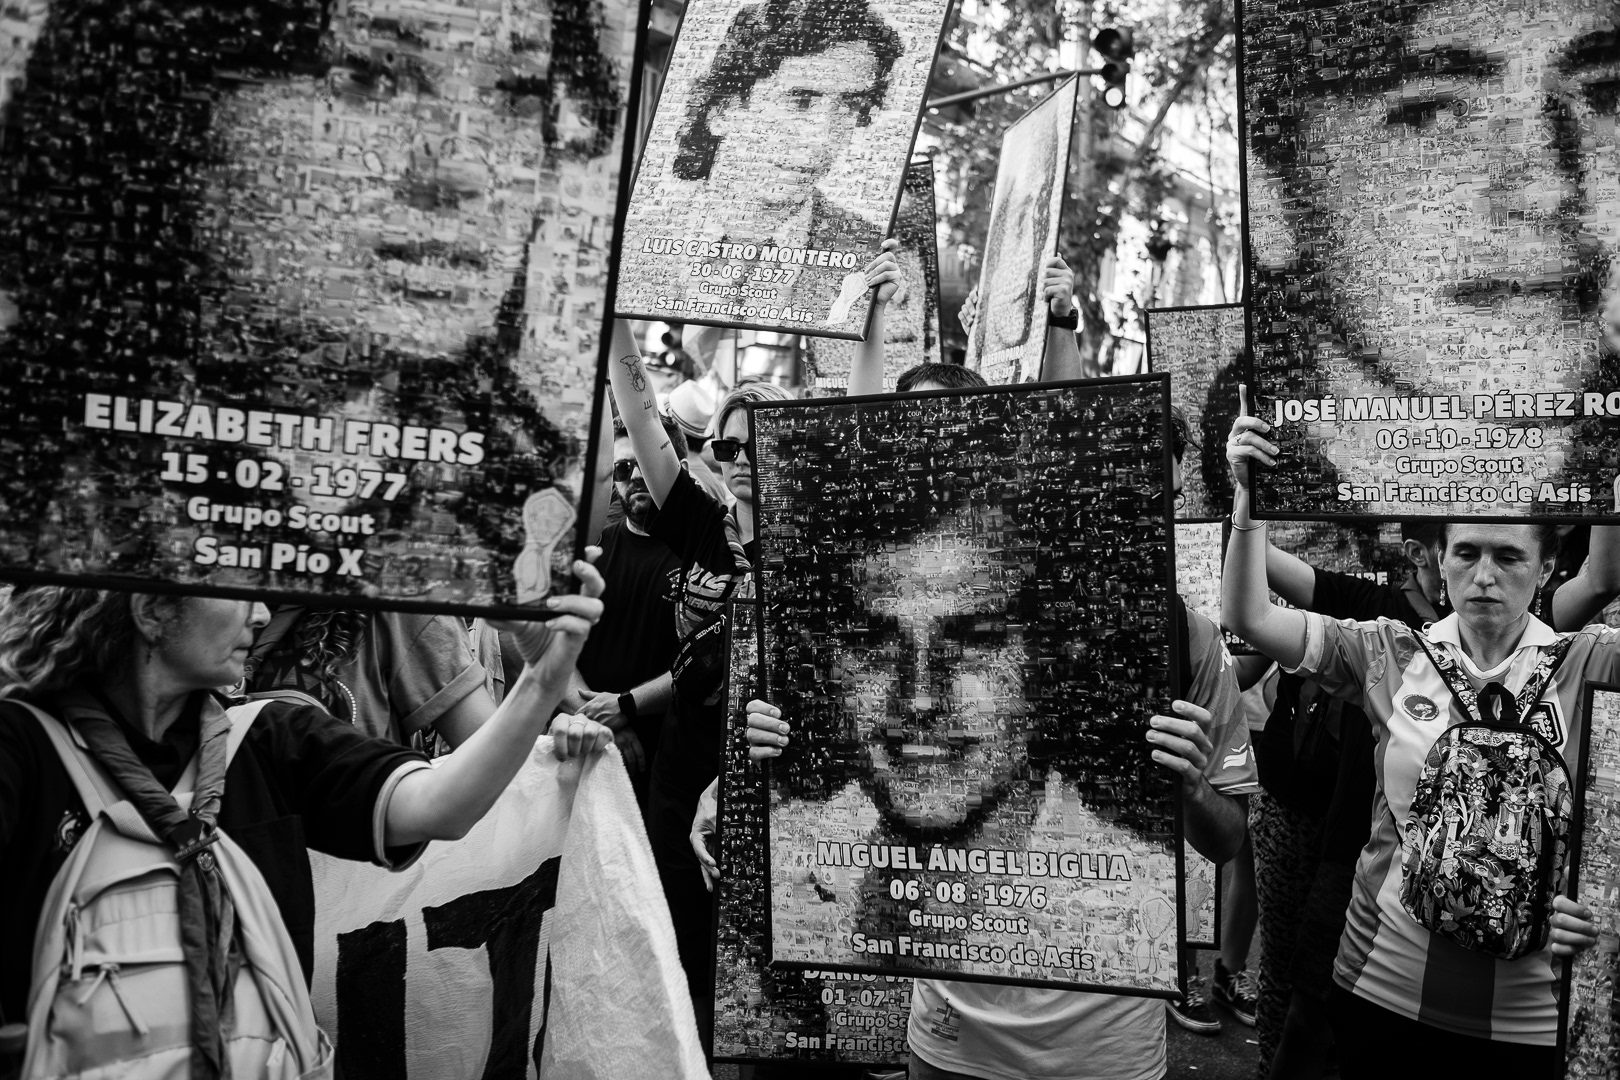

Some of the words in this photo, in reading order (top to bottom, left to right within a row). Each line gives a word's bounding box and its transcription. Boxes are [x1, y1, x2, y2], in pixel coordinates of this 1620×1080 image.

[642, 238, 684, 255] LUIS
[685, 240, 756, 261] CASTRO
[759, 246, 857, 269] MONTERO
[691, 262, 711, 277] 30
[721, 265, 743, 280] 06
[752, 267, 795, 285] 1977
[699, 281, 738, 298] Grupo
[739, 284, 778, 300] Scout
[655, 296, 684, 312] San
[686, 298, 756, 318] Francisco
[759, 305, 778, 320] de
[780, 306, 814, 324] Asís
[1272, 394, 1337, 428] JOSÉ
[1342, 396, 1468, 422] MANUEL
[1473, 389, 1575, 419] PÉREZ
[84, 393, 334, 452] ELIZABETH
[343, 419, 486, 466] FRERS
[1375, 428, 1408, 451] 06
[1425, 428, 1458, 450] 10
[1474, 427, 1543, 450] 1978
[160, 452, 209, 484] 15
[235, 459, 283, 491] 02
[311, 466, 407, 502] 1977
[1396, 456, 1458, 478] Grupo
[1461, 455, 1523, 475] Scout
[1337, 482, 1380, 503] San
[1384, 481, 1498, 503] Francisco
[1501, 481, 1533, 503] de
[1537, 482, 1592, 504] Asís
[187, 495, 282, 532] Grupo
[288, 504, 375, 535] Scout
[194, 536, 262, 569] San
[271, 542, 331, 575] Pío
[337, 547, 364, 577] X
[815, 841, 922, 871] MIGUEL
[927, 843, 1024, 877] ÁNGEL
[1028, 851, 1132, 882] BIGLIA
[889, 878, 921, 902] 06
[935, 880, 967, 905] 08
[982, 883, 1048, 910] 1976
[908, 908, 968, 935] Grupo
[971, 911, 1030, 935] Scout
[851, 932, 894, 956] San
[898, 935, 1006, 964] Francisco
[1008, 942, 1038, 967] de
[1041, 945, 1096, 972] Asís
[821, 988, 848, 1006] 01
[860, 989, 887, 1008] 07
[836, 1011, 886, 1032] Grupo
[785, 1031, 821, 1050] San
